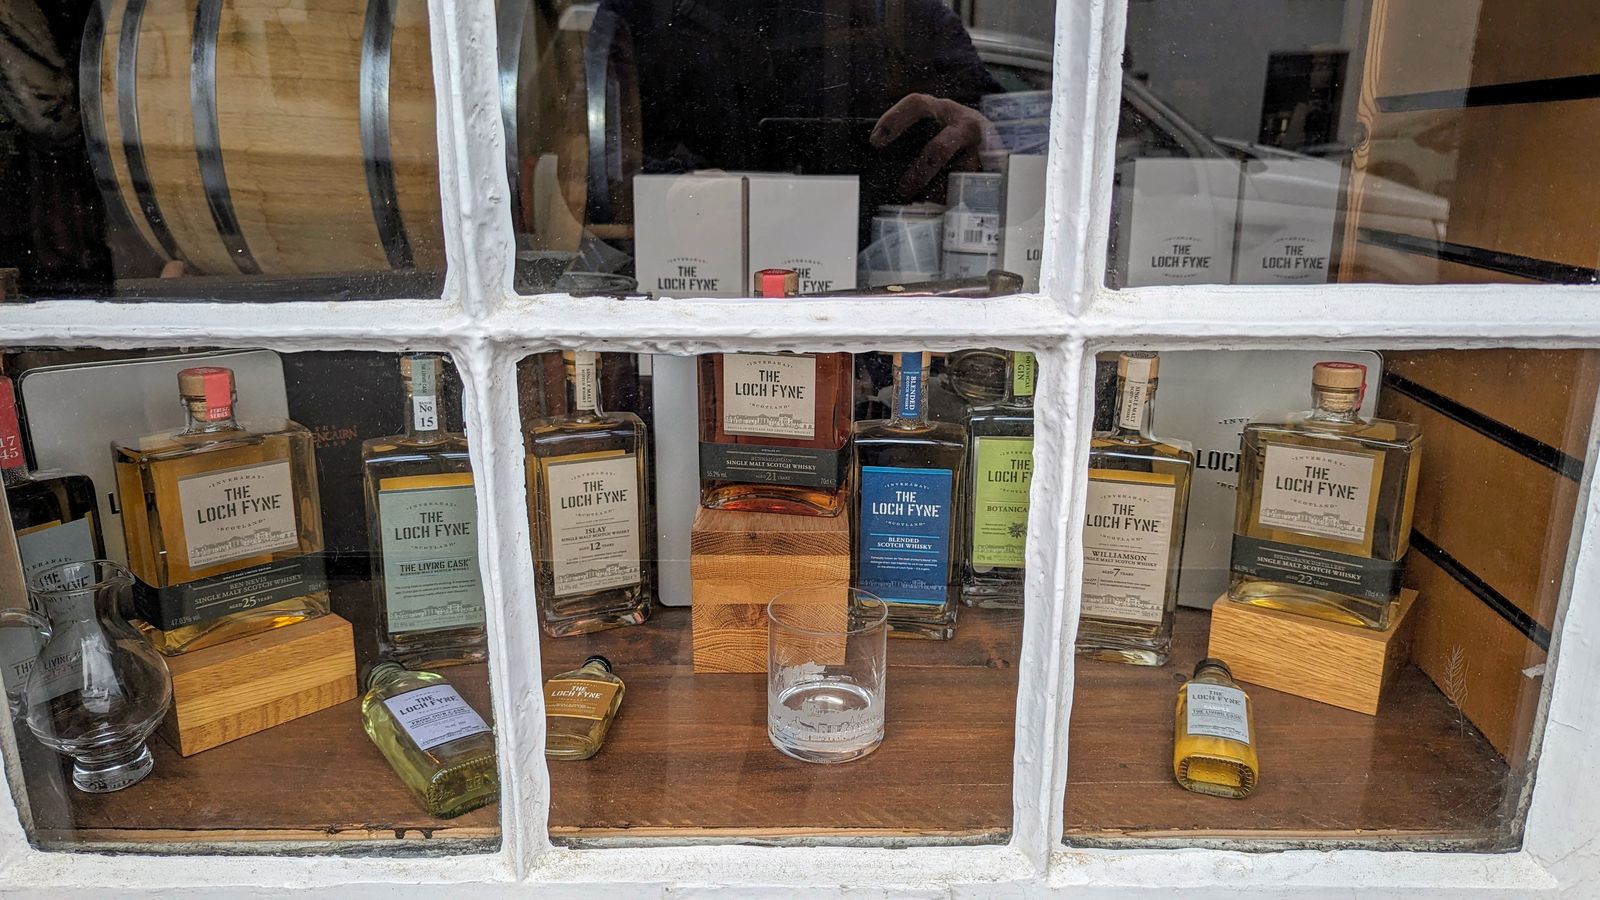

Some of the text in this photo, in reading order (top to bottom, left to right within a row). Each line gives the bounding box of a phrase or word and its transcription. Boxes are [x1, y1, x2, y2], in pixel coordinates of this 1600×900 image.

[1172, 244, 1192, 255] THE
[1285, 245, 1304, 256] THE
[1151, 255, 1212, 269] LOCH FYNE
[1262, 256, 1327, 270] LOCH FYNE
[678, 265, 697, 278] THE
[658, 277, 720, 292] LOCH FYNE
[803, 280, 834, 292] FYNE
[759, 369, 781, 383] THE
[735, 382, 805, 399] LOCH FYNE
[909, 376, 917, 411] BLENDED
[419, 404, 433, 413] No
[420, 417, 434, 427] 15
[1011, 459, 1031, 471] THE
[765, 471, 777, 481] 21
[987, 470, 1018, 483] LOCH
[1304, 465, 1330, 481] THE
[224, 485, 251, 502] THE
[583, 480, 605, 493] THE
[1275, 475, 1359, 500] LOCH FYNE
[561, 489, 629, 510] LOCH FYNE
[896, 491, 917, 503] THE
[196, 494, 282, 525] LOCH FYNE
[872, 502, 942, 518] LOCH FYNE
[1112, 503, 1135, 517] THE
[419, 511, 444, 524] THE
[1086, 513, 1161, 533] LOCH FYNE
[395, 522, 471, 541] LOCH FYNE
[585, 526, 607, 535] ISLAY
[590, 542, 602, 551] 12
[1091, 550, 1148, 562] WILLIAMSON
[400, 559, 470, 573] THE LIVING CASK
[1113, 567, 1121, 577] 7
[1256, 556, 1362, 580] SINGLE MALT SCOTCH WHISKY
[229, 576, 267, 590] BEN NEVIS
[1297, 574, 1313, 585] 22
[195, 574, 302, 605] SINGLE MALT SCOTCH WHISKY
[242, 595, 258, 609] 25
[416, 694, 435, 705] THE
[577, 690, 604, 700] FYNE
[399, 702, 429, 716] LOCH
[431, 695, 459, 706] FYNE
